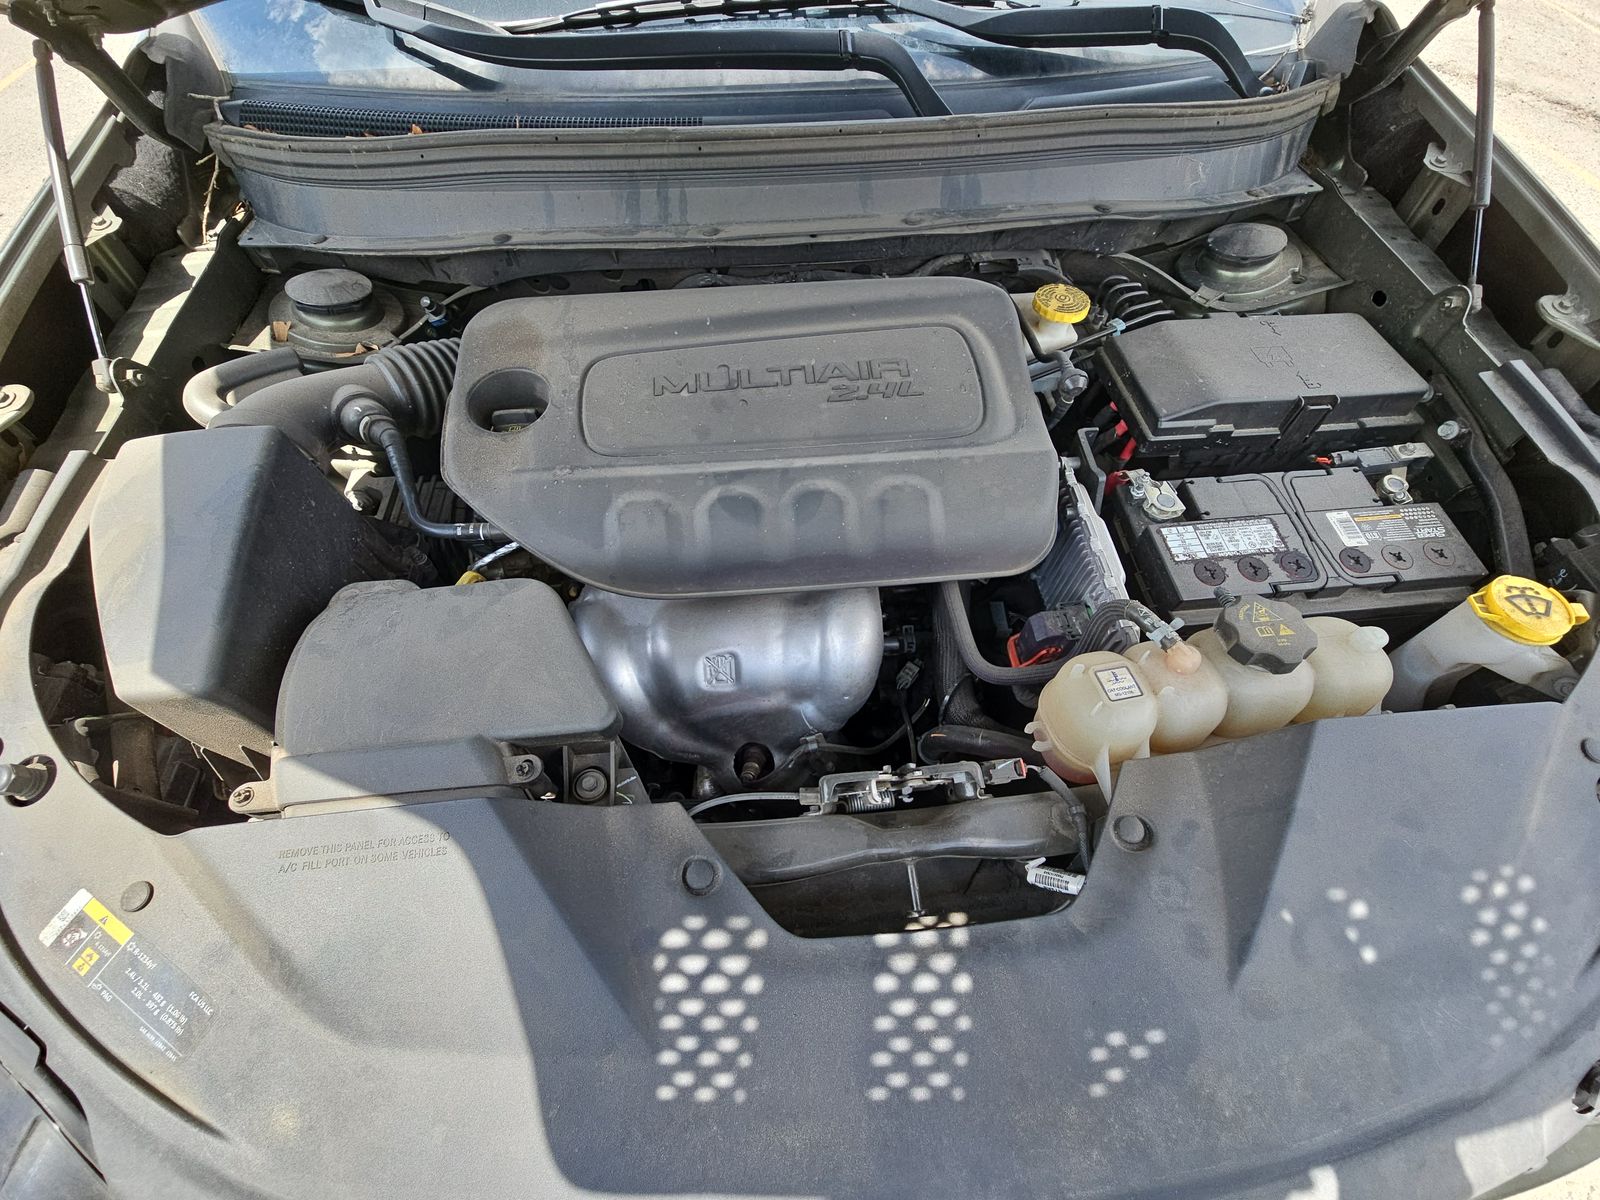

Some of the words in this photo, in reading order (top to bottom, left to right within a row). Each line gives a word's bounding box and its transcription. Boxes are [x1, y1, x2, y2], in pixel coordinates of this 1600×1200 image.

[826, 381, 925, 402] 2.4L
[1415, 526, 1446, 534] START
[278, 846, 319, 859] REMOVE
[320, 843, 343, 854] THIS
[345, 840, 375, 852] PANEL
[377, 837, 398, 849] FOR
[400, 833, 436, 846] ACCESS
[438, 831, 450, 842] TO
[278, 861, 298, 874] A/C
[302, 858, 322, 871] FILL
[325, 856, 351, 869] PORT
[353, 854, 368, 865] ON
[370, 851, 399, 863] SOME
[402, 847, 447, 860] VEHICLES
[132, 947, 157, 971] R-1234yf
[188, 991, 200, 1003] FCA
[197, 999, 206, 1008] US
[203, 1006, 213, 1015] LLC
